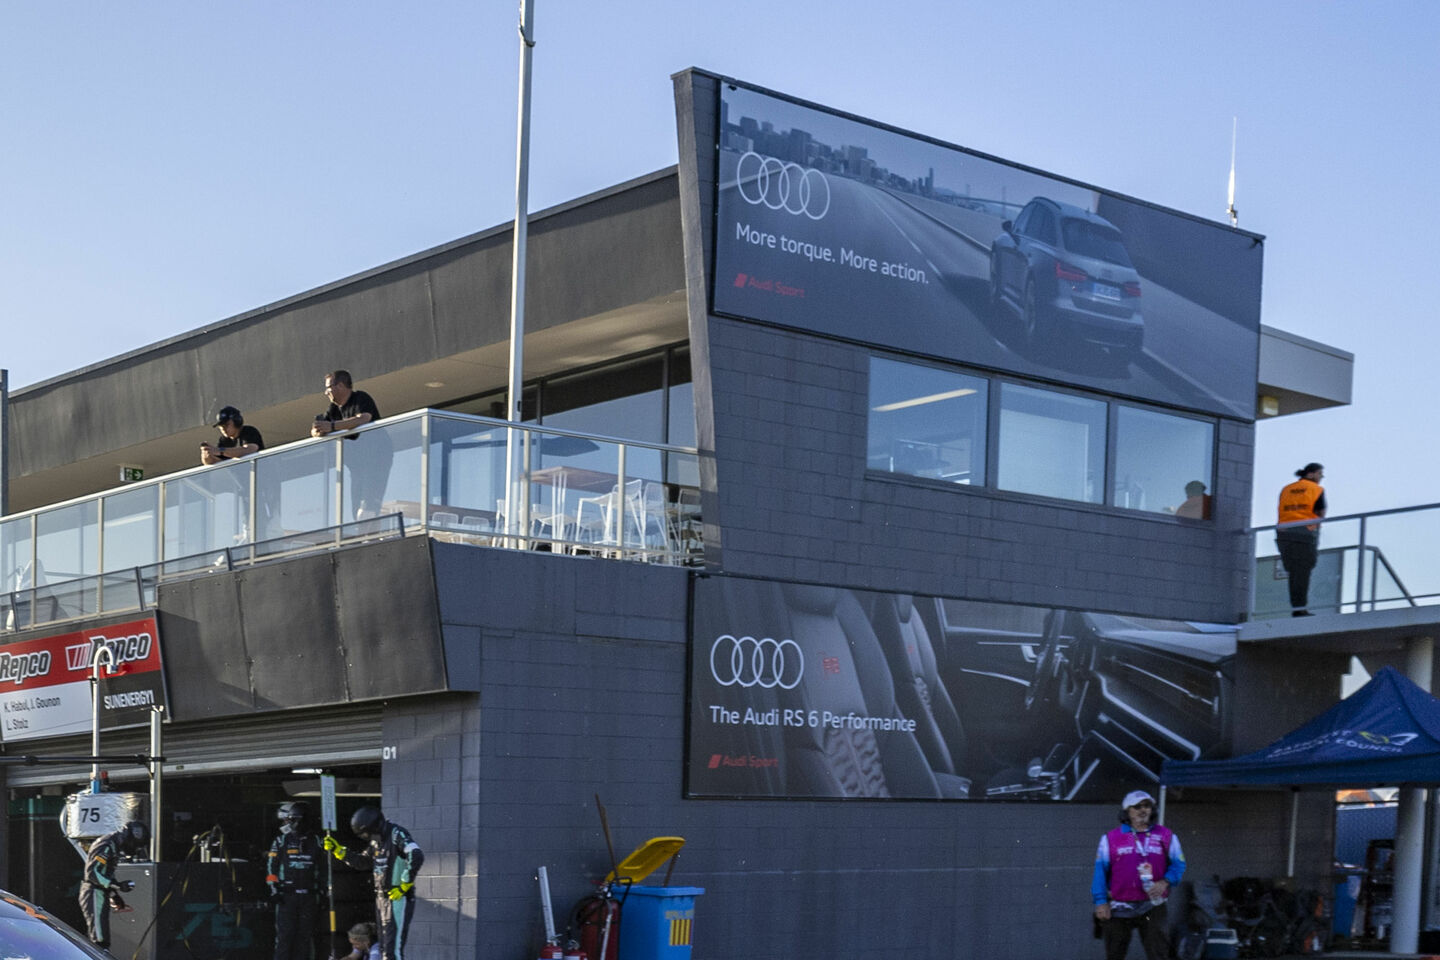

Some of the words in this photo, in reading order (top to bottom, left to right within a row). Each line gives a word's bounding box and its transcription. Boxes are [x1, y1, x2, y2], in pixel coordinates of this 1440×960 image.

[736, 222, 776, 248] More
[780, 236, 836, 262] torque.
[840, 248, 877, 272] More
[881, 259, 929, 284] action.
[748, 277, 773, 291] Audi
[776, 281, 805, 298] Sport
[710, 705, 740, 724] The
[744, 707, 779, 726] Audi
[783, 709, 804, 727] RS
[808, 711, 819, 728] 6
[822, 711, 916, 732] Performance
[383, 746, 397, 760] 01
[722, 755, 747, 767] Audi
[749, 755, 778, 768] Sport
[81, 808, 100, 823] 75
